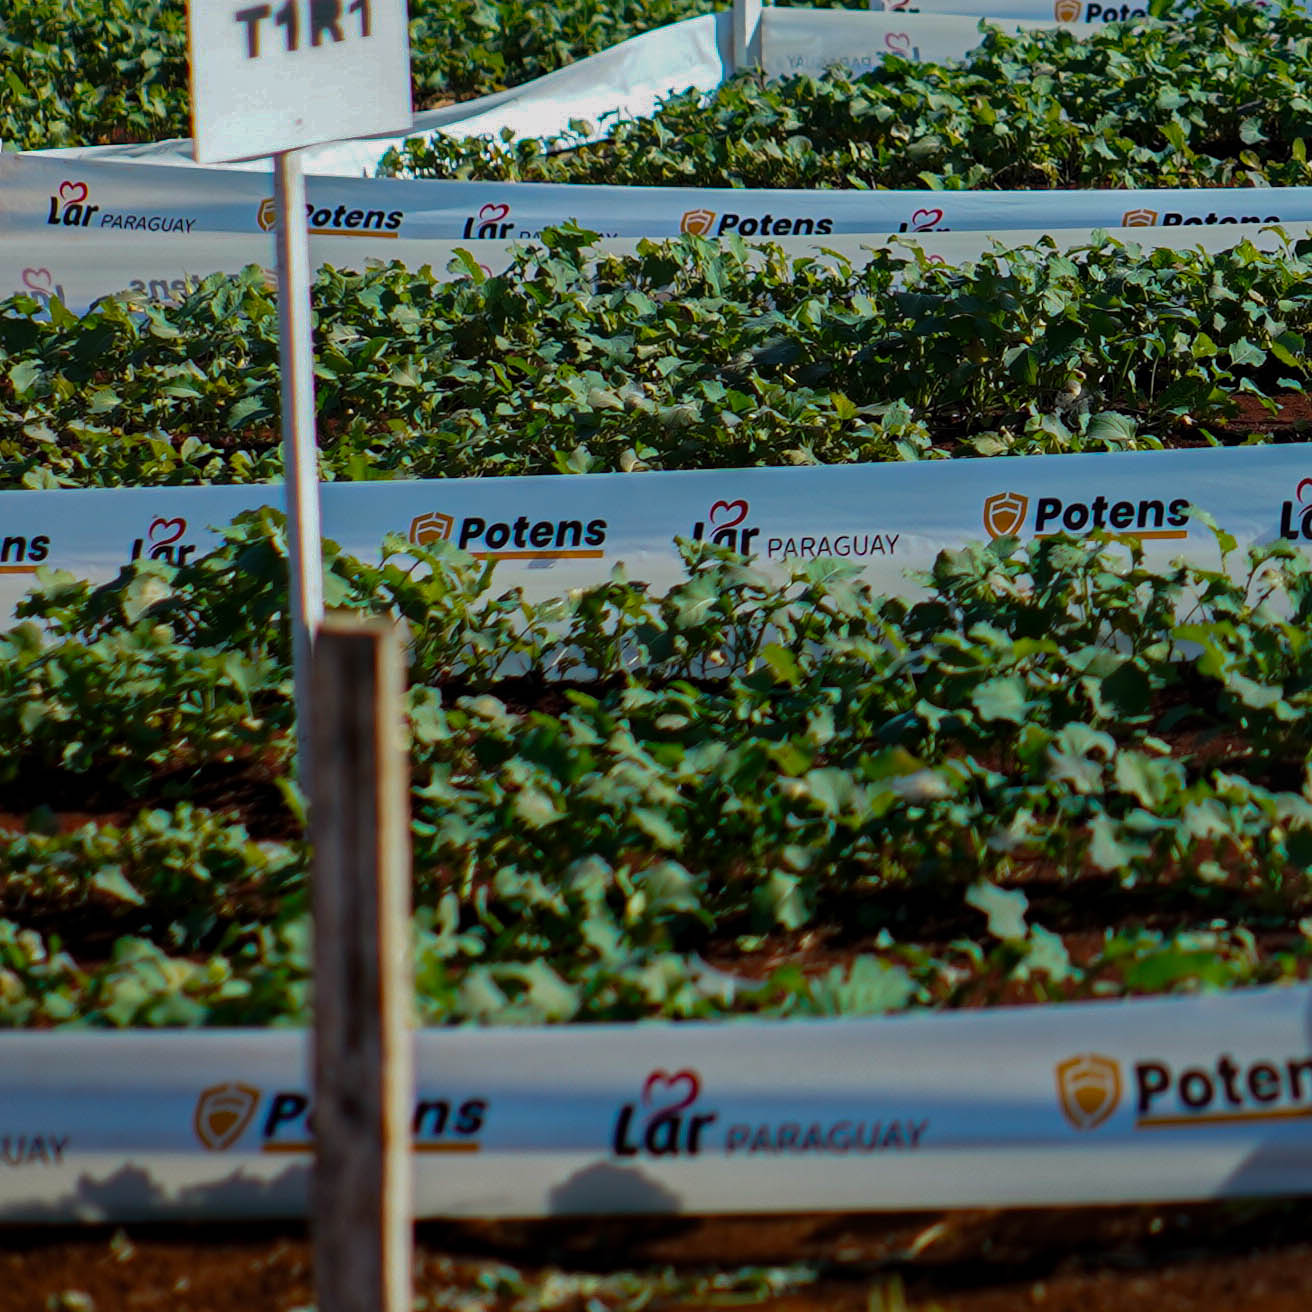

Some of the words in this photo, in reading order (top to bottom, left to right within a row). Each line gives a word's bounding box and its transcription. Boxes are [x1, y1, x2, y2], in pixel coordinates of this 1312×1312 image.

[1085, 2, 1146, 23] Pote
[48, 196, 99, 227] Lar
[100, 213, 197, 234] PARAGUAY
[719, 214, 834, 237] Potens
[1034, 495, 1191, 531] Potens
[458, 516, 608, 549] Potens
[767, 534, 900, 558] PARAGUAY
[611, 1103, 717, 1157] Lar
[725, 1117, 929, 1154] PARAGUAY
